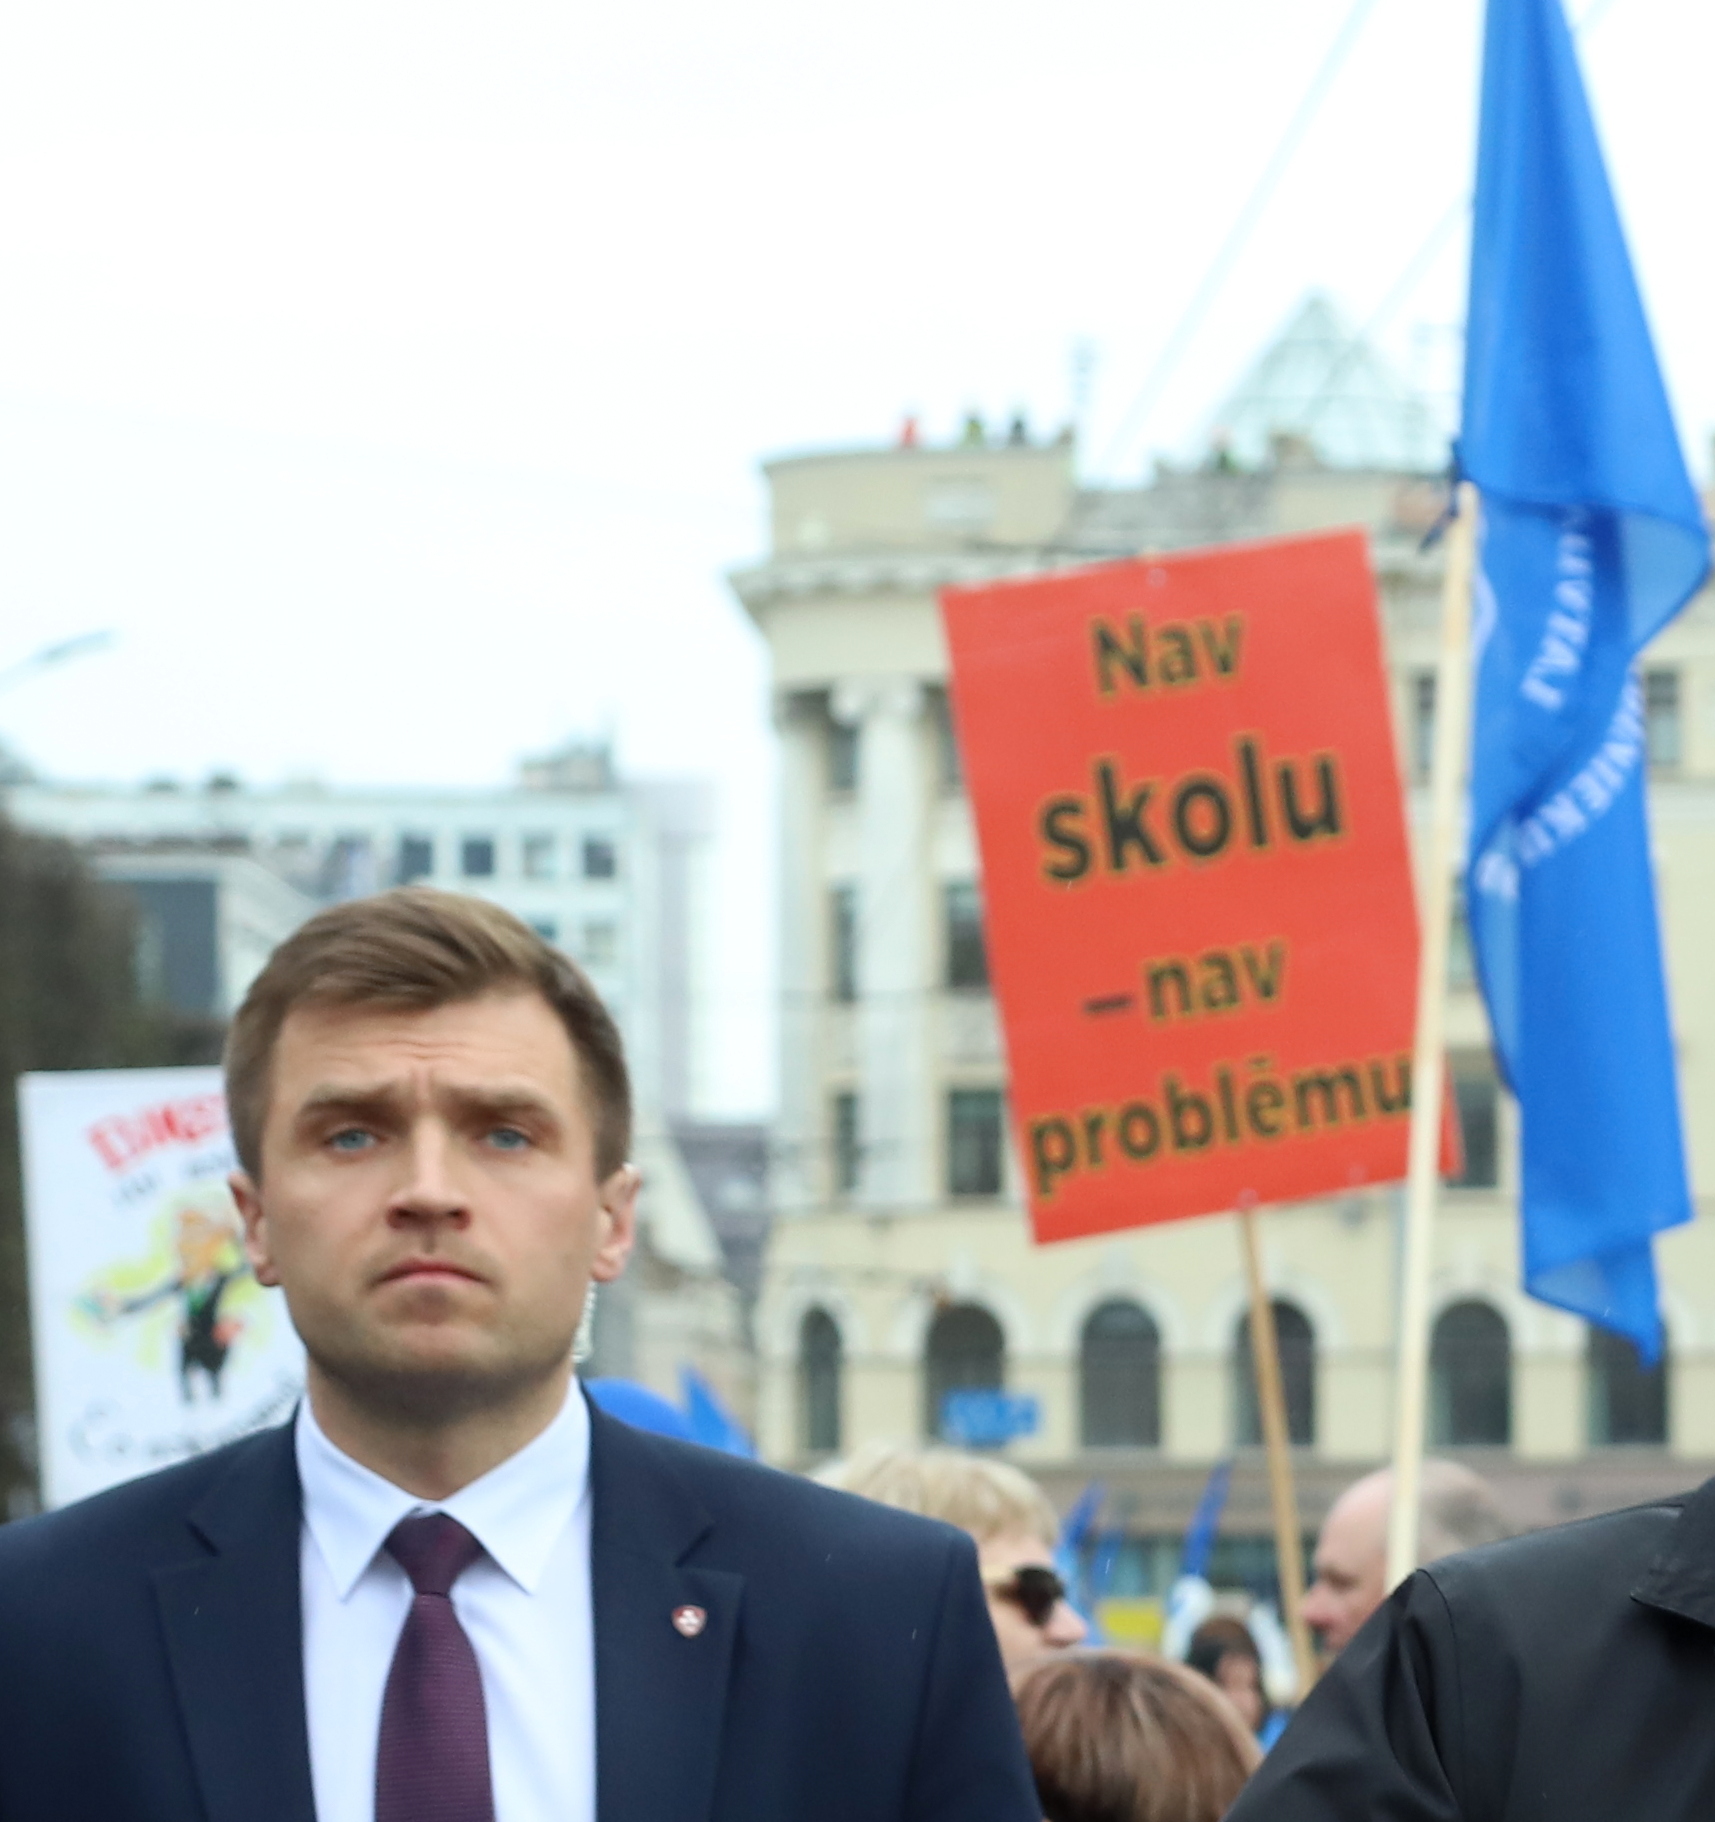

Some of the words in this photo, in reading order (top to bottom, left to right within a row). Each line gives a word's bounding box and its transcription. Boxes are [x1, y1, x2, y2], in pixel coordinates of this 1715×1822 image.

[1090, 614, 1242, 695] Nav
[1037, 735, 1345, 886] skolu
[1027, 1054, 1412, 1200] problēmu
